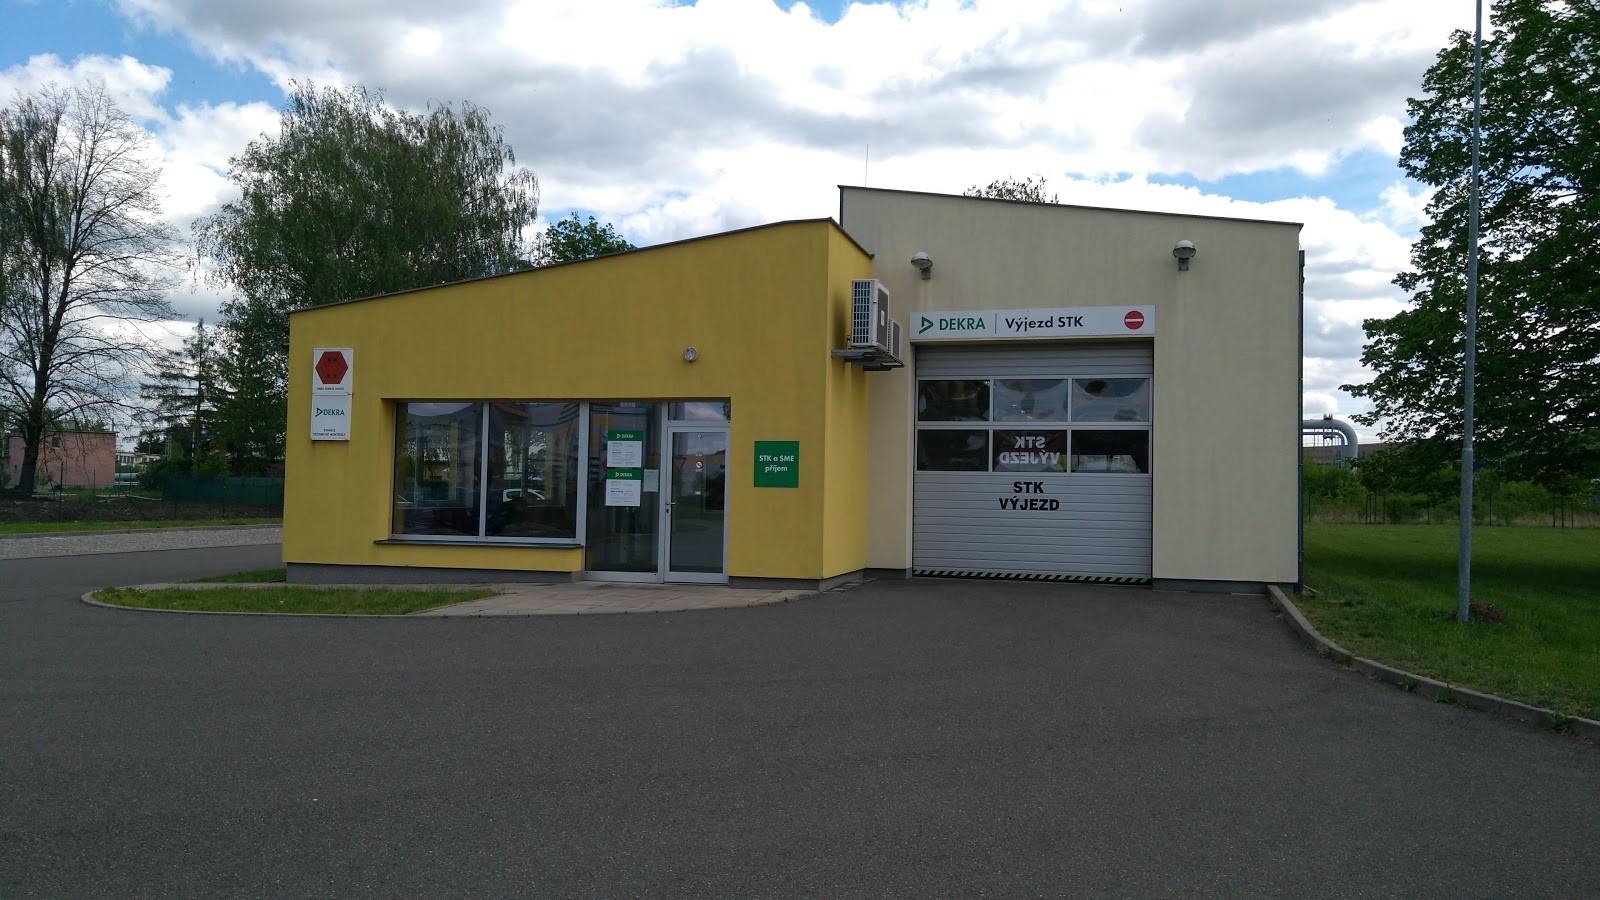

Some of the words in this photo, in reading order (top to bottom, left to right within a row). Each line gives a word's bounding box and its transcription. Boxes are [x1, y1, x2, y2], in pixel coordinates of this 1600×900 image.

[939, 317, 986, 331] DEKRA
[1005, 316, 1053, 332] Výjezd
[1058, 316, 1084, 328] STK
[765, 464, 788, 473] příjem
[1013, 481, 1044, 494] STK
[999, 496, 1060, 511] VÝJEZD
